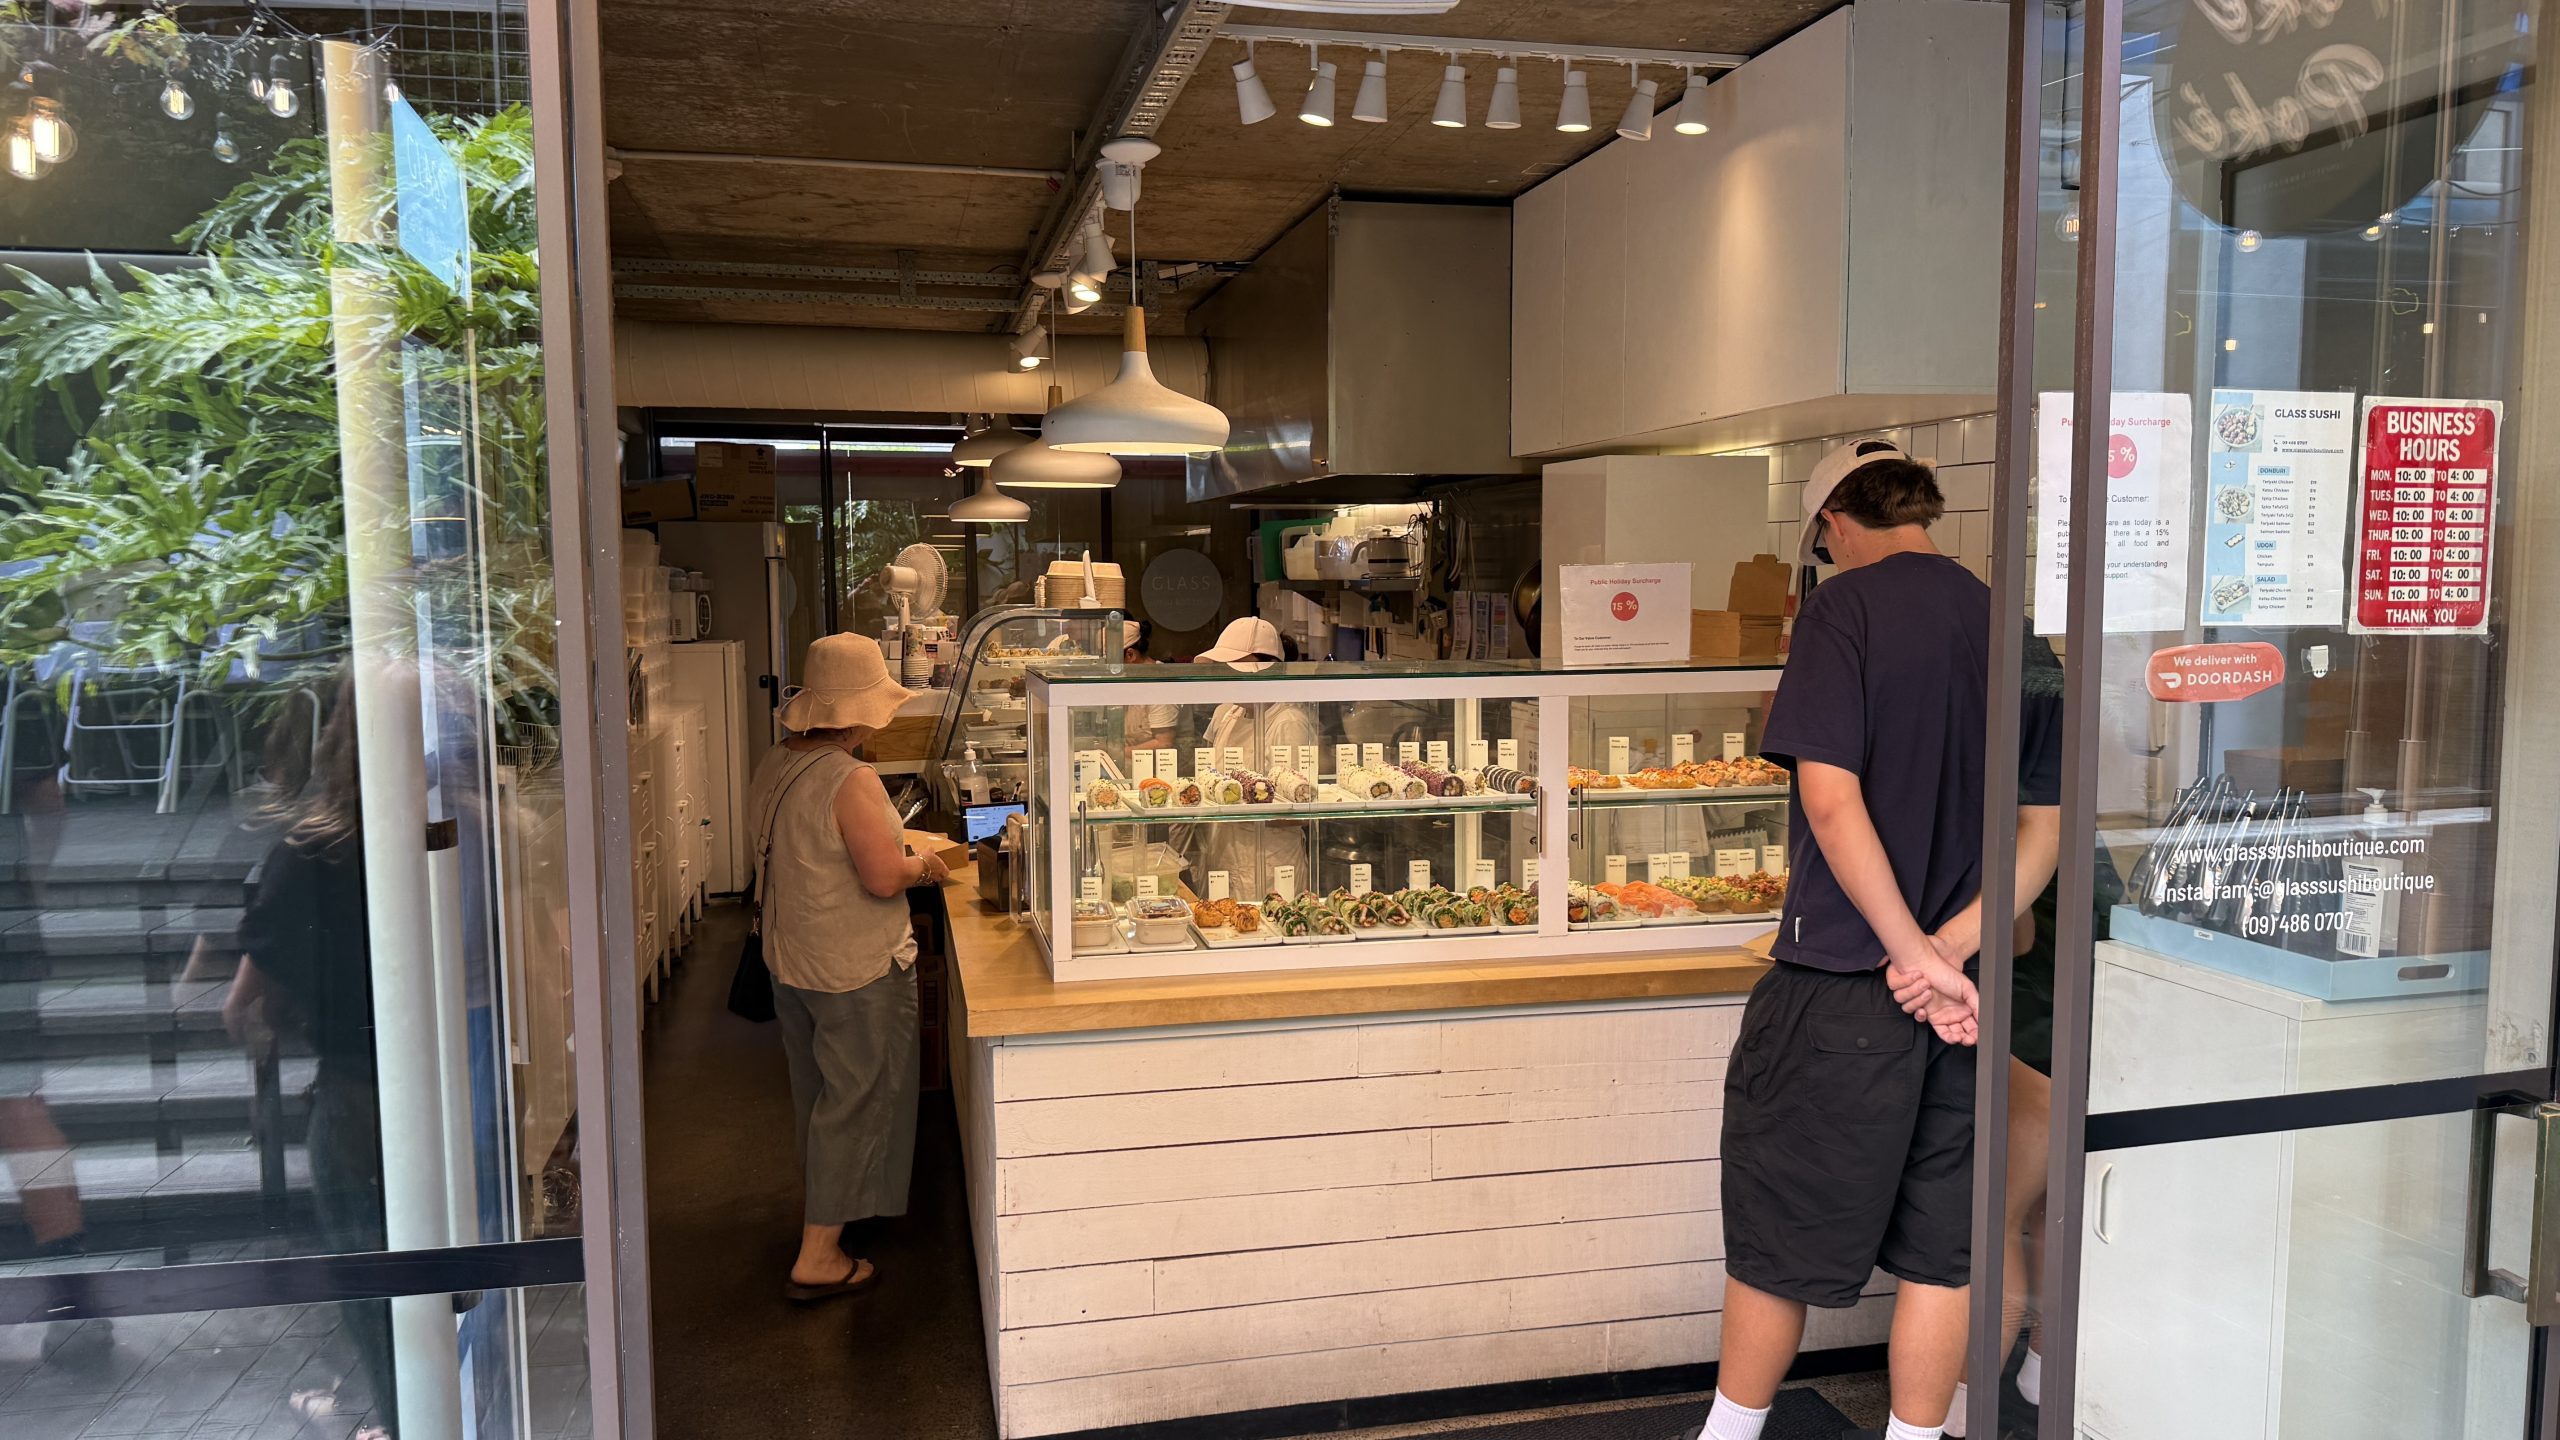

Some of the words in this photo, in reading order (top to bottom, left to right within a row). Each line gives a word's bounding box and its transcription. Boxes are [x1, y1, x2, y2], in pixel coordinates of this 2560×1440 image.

[2274, 408, 2306, 419] GLASS
[2308, 409, 2341, 419] SUSHI
[2128, 417, 2171, 428] Surcharge
[2386, 411, 2476, 436] BUSINESS
[2108, 450, 2115, 462] 5
[2120, 446, 2135, 462] %
[2400, 438, 2460, 462] HOURS
[2370, 470, 2392, 480] MON.
[2436, 470, 2446, 480] TO
[2370, 490, 2394, 500] TUES.
[2436, 490, 2446, 500] TO
[2369, 510, 2390, 521] WED.
[2434, 510, 2444, 521] TO
[2368, 530, 2392, 541] THUR.
[2433, 530, 2444, 540] TO
[2366, 550, 2382, 560] FRI.
[2432, 550, 2442, 560] TO
[2366, 569, 2382, 580] SAT.
[2431, 569, 2441, 580] TO
[1152, 576, 1210, 590] GLASS
[2364, 589, 2383, 600] SUN.
[2429, 589, 2440, 599] TO
[1612, 602, 1623, 611] 15
[1626, 600, 1637, 610] %
[2386, 608, 2428, 623] THANK
[2433, 608, 2457, 622] YOU
[2174, 656, 2192, 666] We
[2194, 655, 2231, 666] deliver
[2233, 654, 2257, 664] with
[2187, 670, 2272, 686] DOORDASH
[2174, 838, 2425, 866] www.glasssushiboutique.com
[2242, 914, 2276, 938] (09)
[2280, 914, 2310, 933] 486
[2314, 912, 2354, 931] 0707
